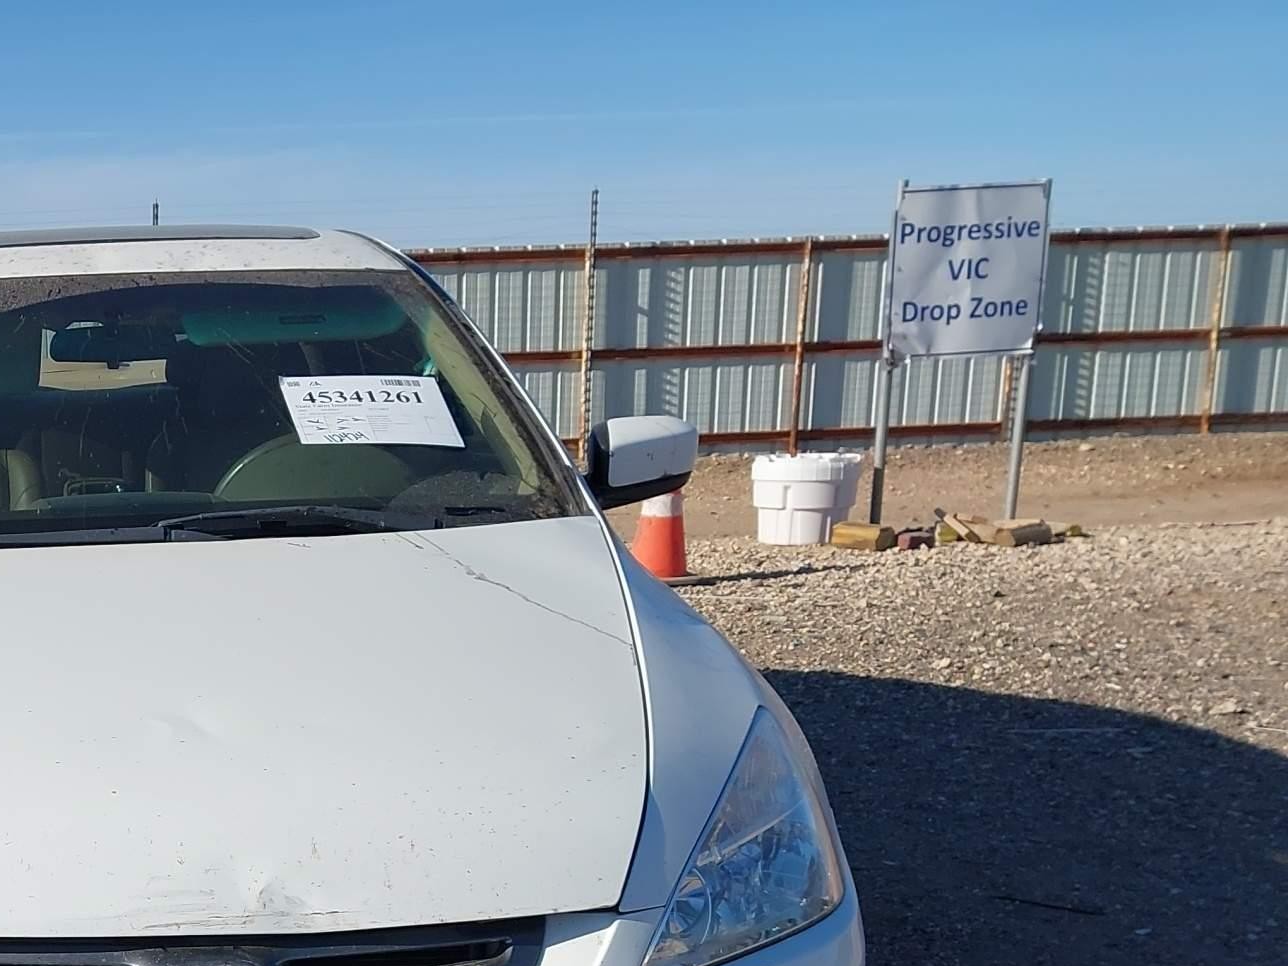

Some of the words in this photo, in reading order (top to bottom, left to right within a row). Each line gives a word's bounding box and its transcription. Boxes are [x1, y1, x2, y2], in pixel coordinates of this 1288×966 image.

[900, 216, 1041, 248] Progressive
[948, 257, 990, 281] VIC
[902, 302, 961, 326] Drop
[969, 297, 1029, 319] Zone
[302, 390, 424, 404] 45341261
